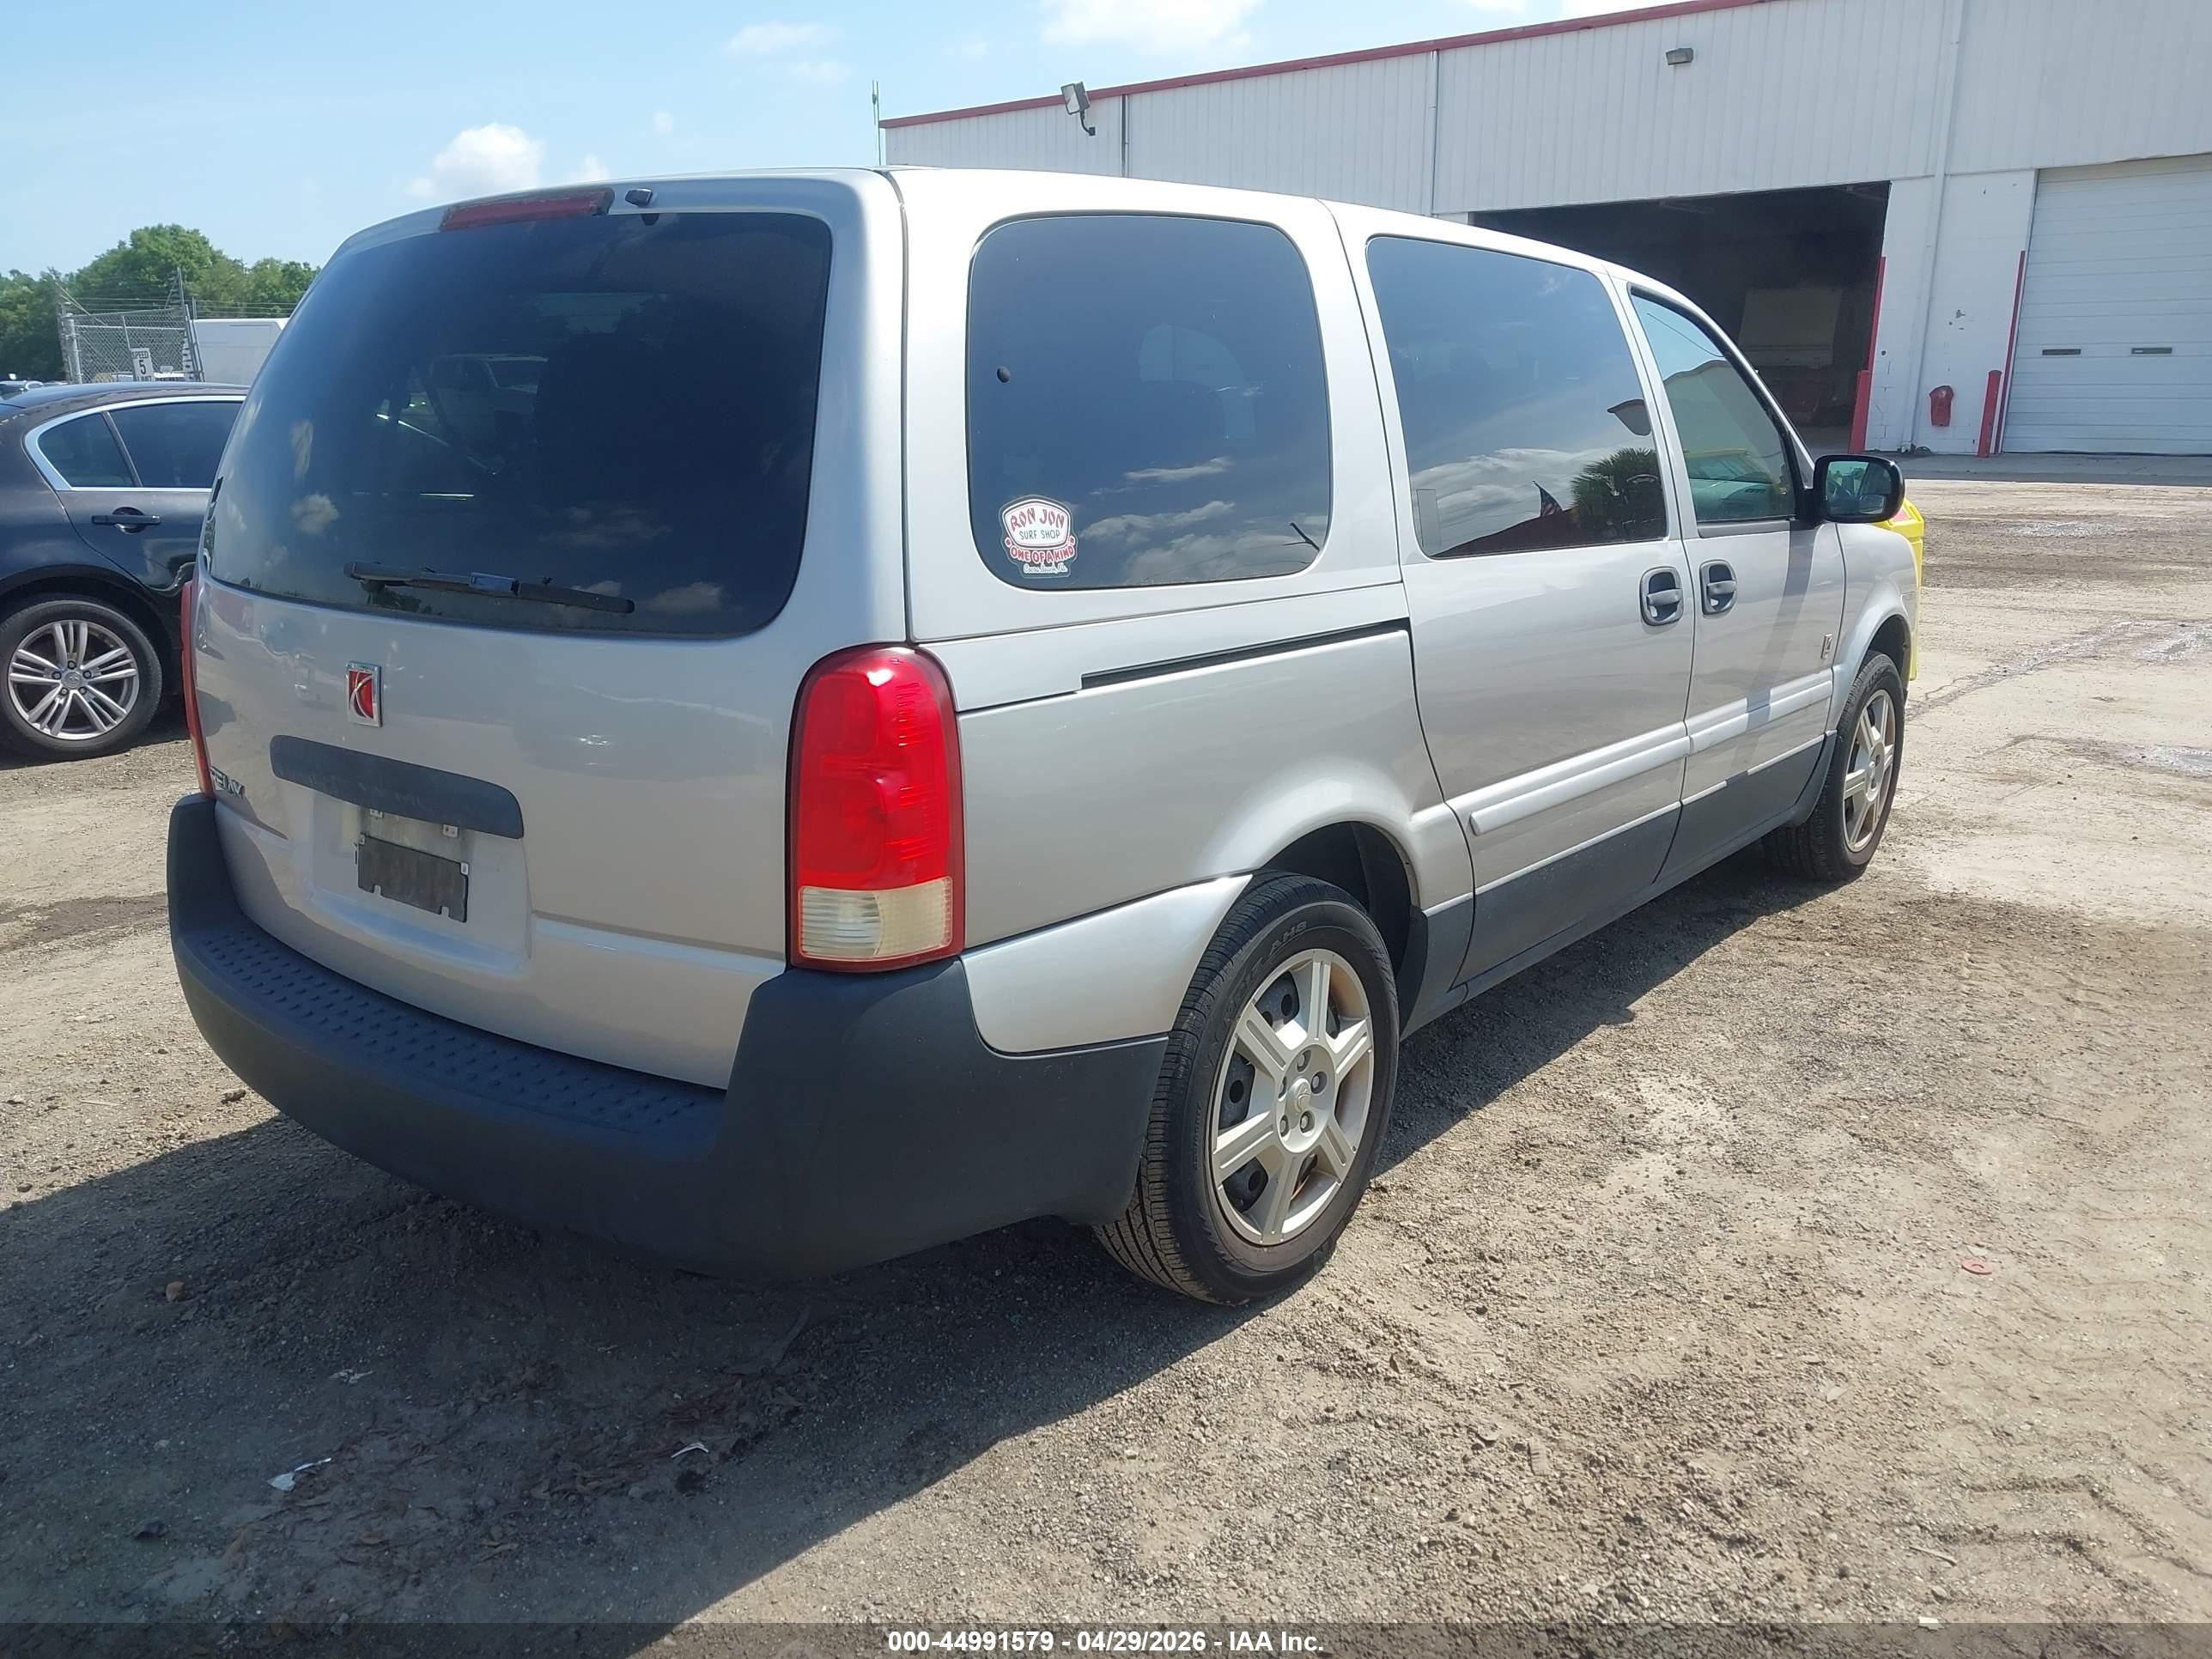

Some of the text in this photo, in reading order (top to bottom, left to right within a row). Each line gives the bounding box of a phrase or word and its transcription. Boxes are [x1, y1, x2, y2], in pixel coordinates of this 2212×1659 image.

[131, 350, 149, 359] SPEED
[139, 360, 146, 374] 5
[1011, 507, 1065, 532] RON JON
[1018, 529, 1060, 540] SURF SHOP
[1011, 545, 1075, 563] ONE OF A KIND
